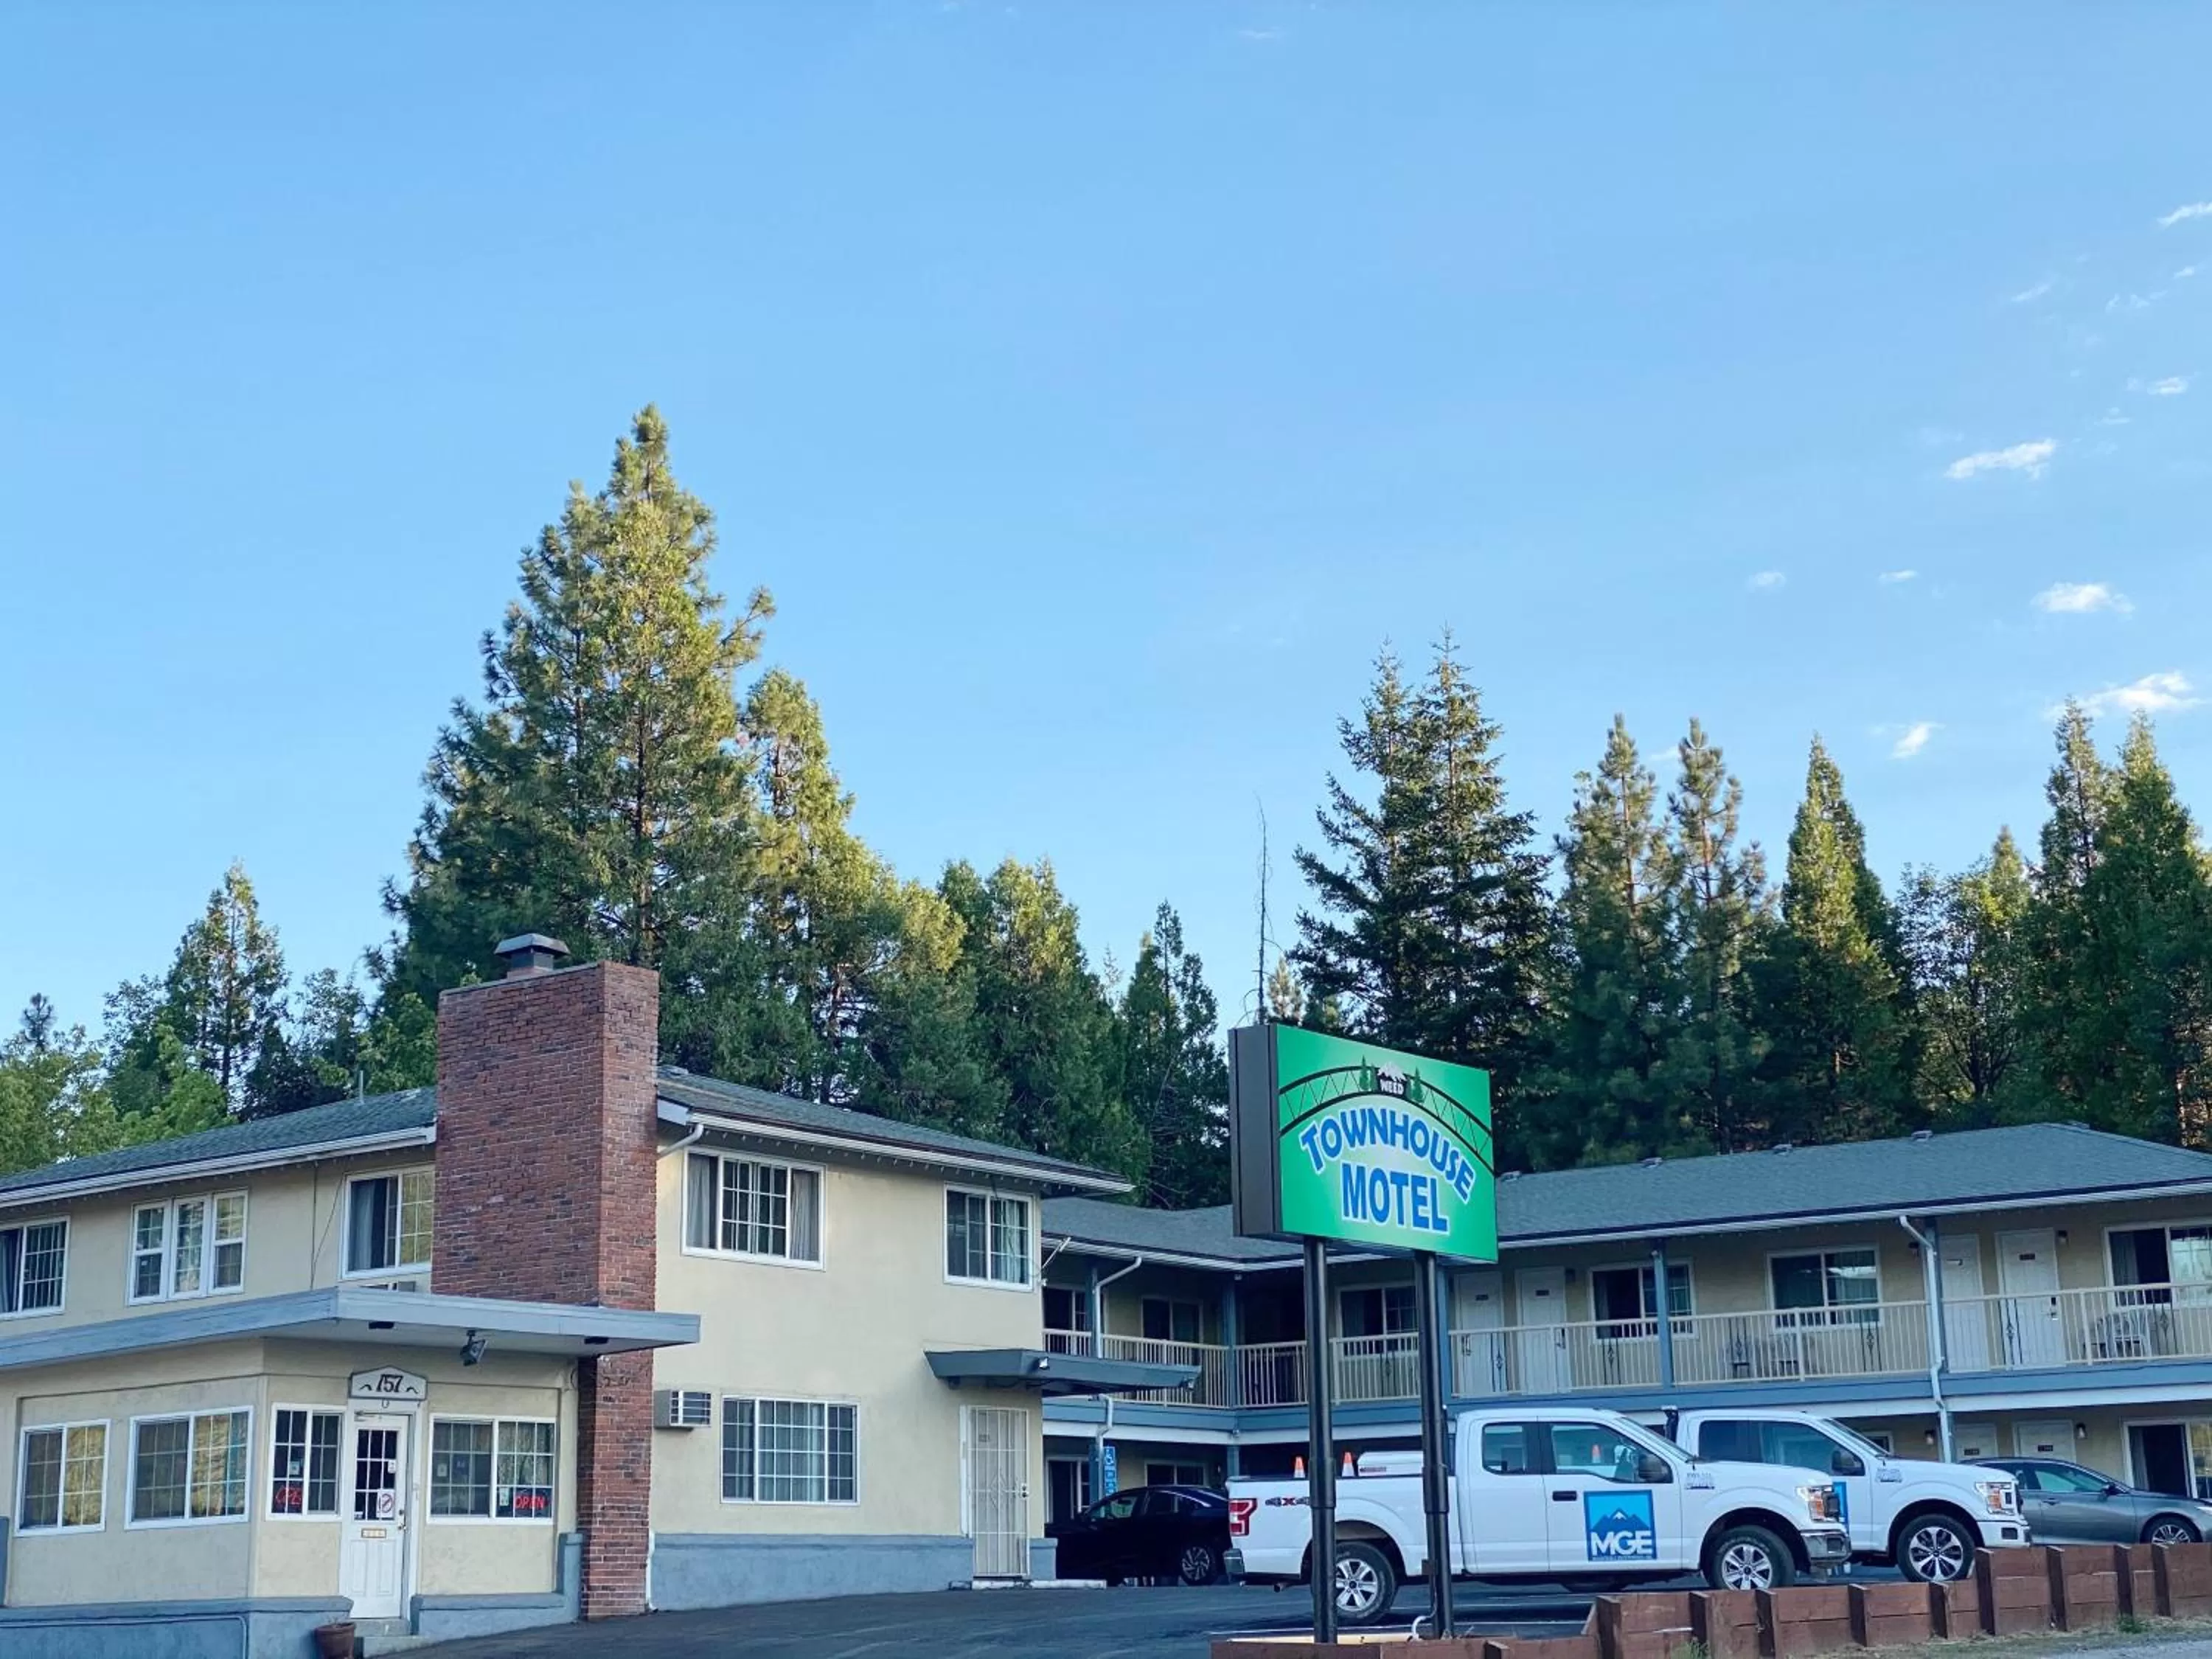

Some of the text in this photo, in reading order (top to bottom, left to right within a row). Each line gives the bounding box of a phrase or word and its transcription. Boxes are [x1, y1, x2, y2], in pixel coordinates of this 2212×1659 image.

[1380, 1079, 1405, 1095] WEED
[1301, 1107, 1475, 1201] TOWNHOUSE
[1341, 1163, 1448, 1232] MOTEL
[376, 1374, 404, 1393] 157
[515, 1495, 546, 1510] OPEN
[1590, 1530, 1653, 1556] MGE
